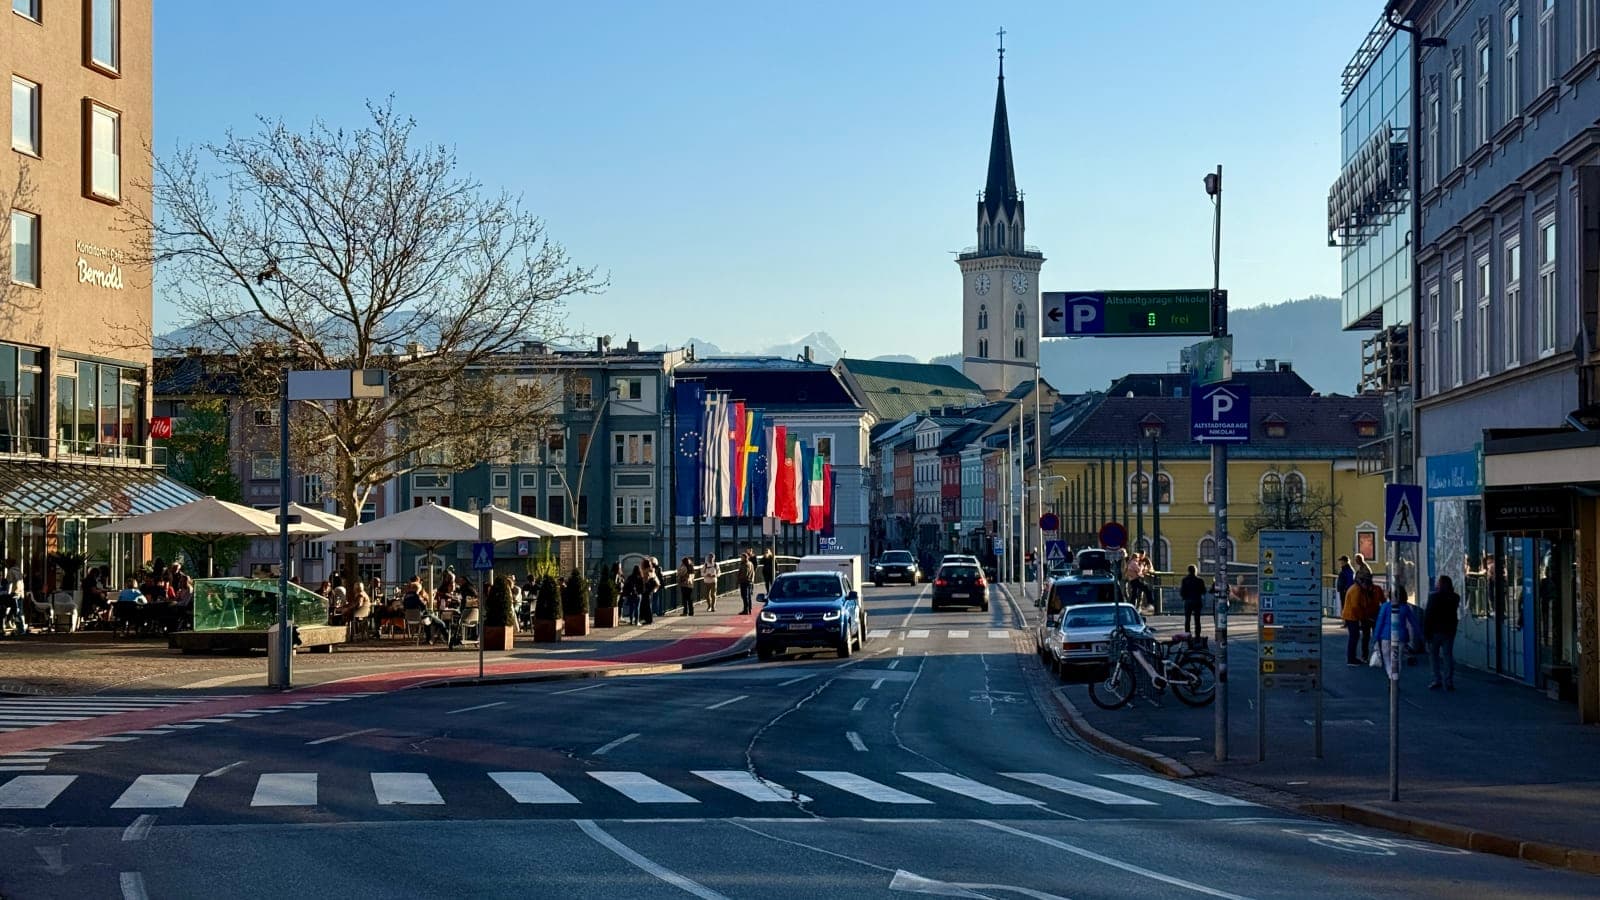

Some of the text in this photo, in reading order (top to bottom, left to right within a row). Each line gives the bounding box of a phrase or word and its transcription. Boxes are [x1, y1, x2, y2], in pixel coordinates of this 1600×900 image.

[77, 256, 124, 290] Bernold
[1105, 295, 1208, 306] Altstadtgarage Nikolai
[1073, 305, 1097, 331] P
[1170, 313, 1189, 324] frei
[1212, 394, 1233, 421] P
[151, 420, 170, 435] illy
